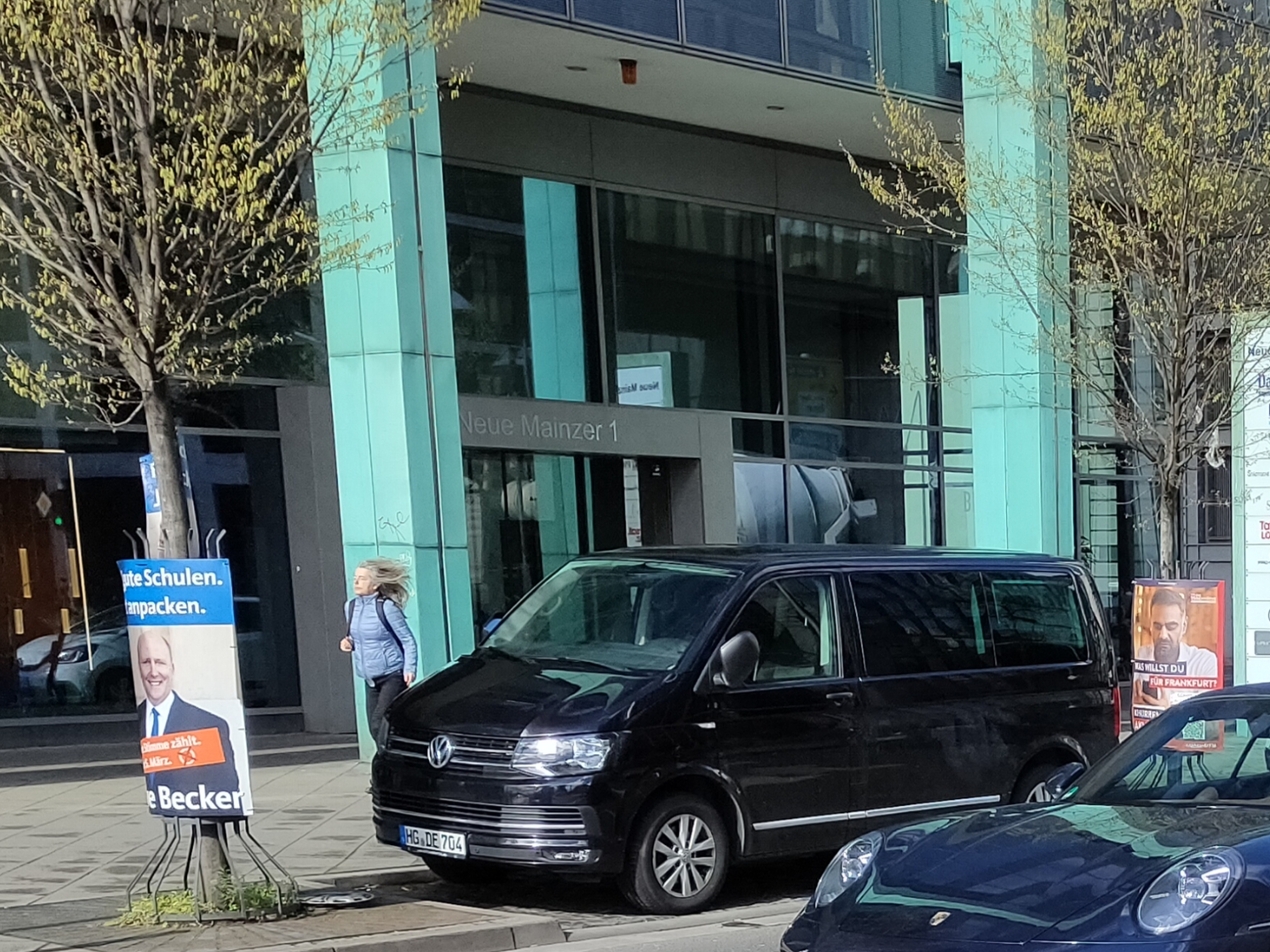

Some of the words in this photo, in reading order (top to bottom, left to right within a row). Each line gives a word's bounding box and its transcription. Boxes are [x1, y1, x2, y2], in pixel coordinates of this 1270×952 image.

[460, 411, 514, 436] Neue
[521, 414, 603, 442] Mainzer
[608, 419, 619, 442] 1
[143, 568, 224, 586] Schulen.
[1145, 663, 1169, 673] WILLST
[1170, 664, 1185, 673] DU
[1150, 676, 1164, 686] FÜR
[1164, 678, 1218, 689] FRANKFURT?
[157, 784, 243, 811] Becker
[405, 828, 420, 845] HG
[424, 831, 440, 849] DE
[441, 834, 463, 852] 704
